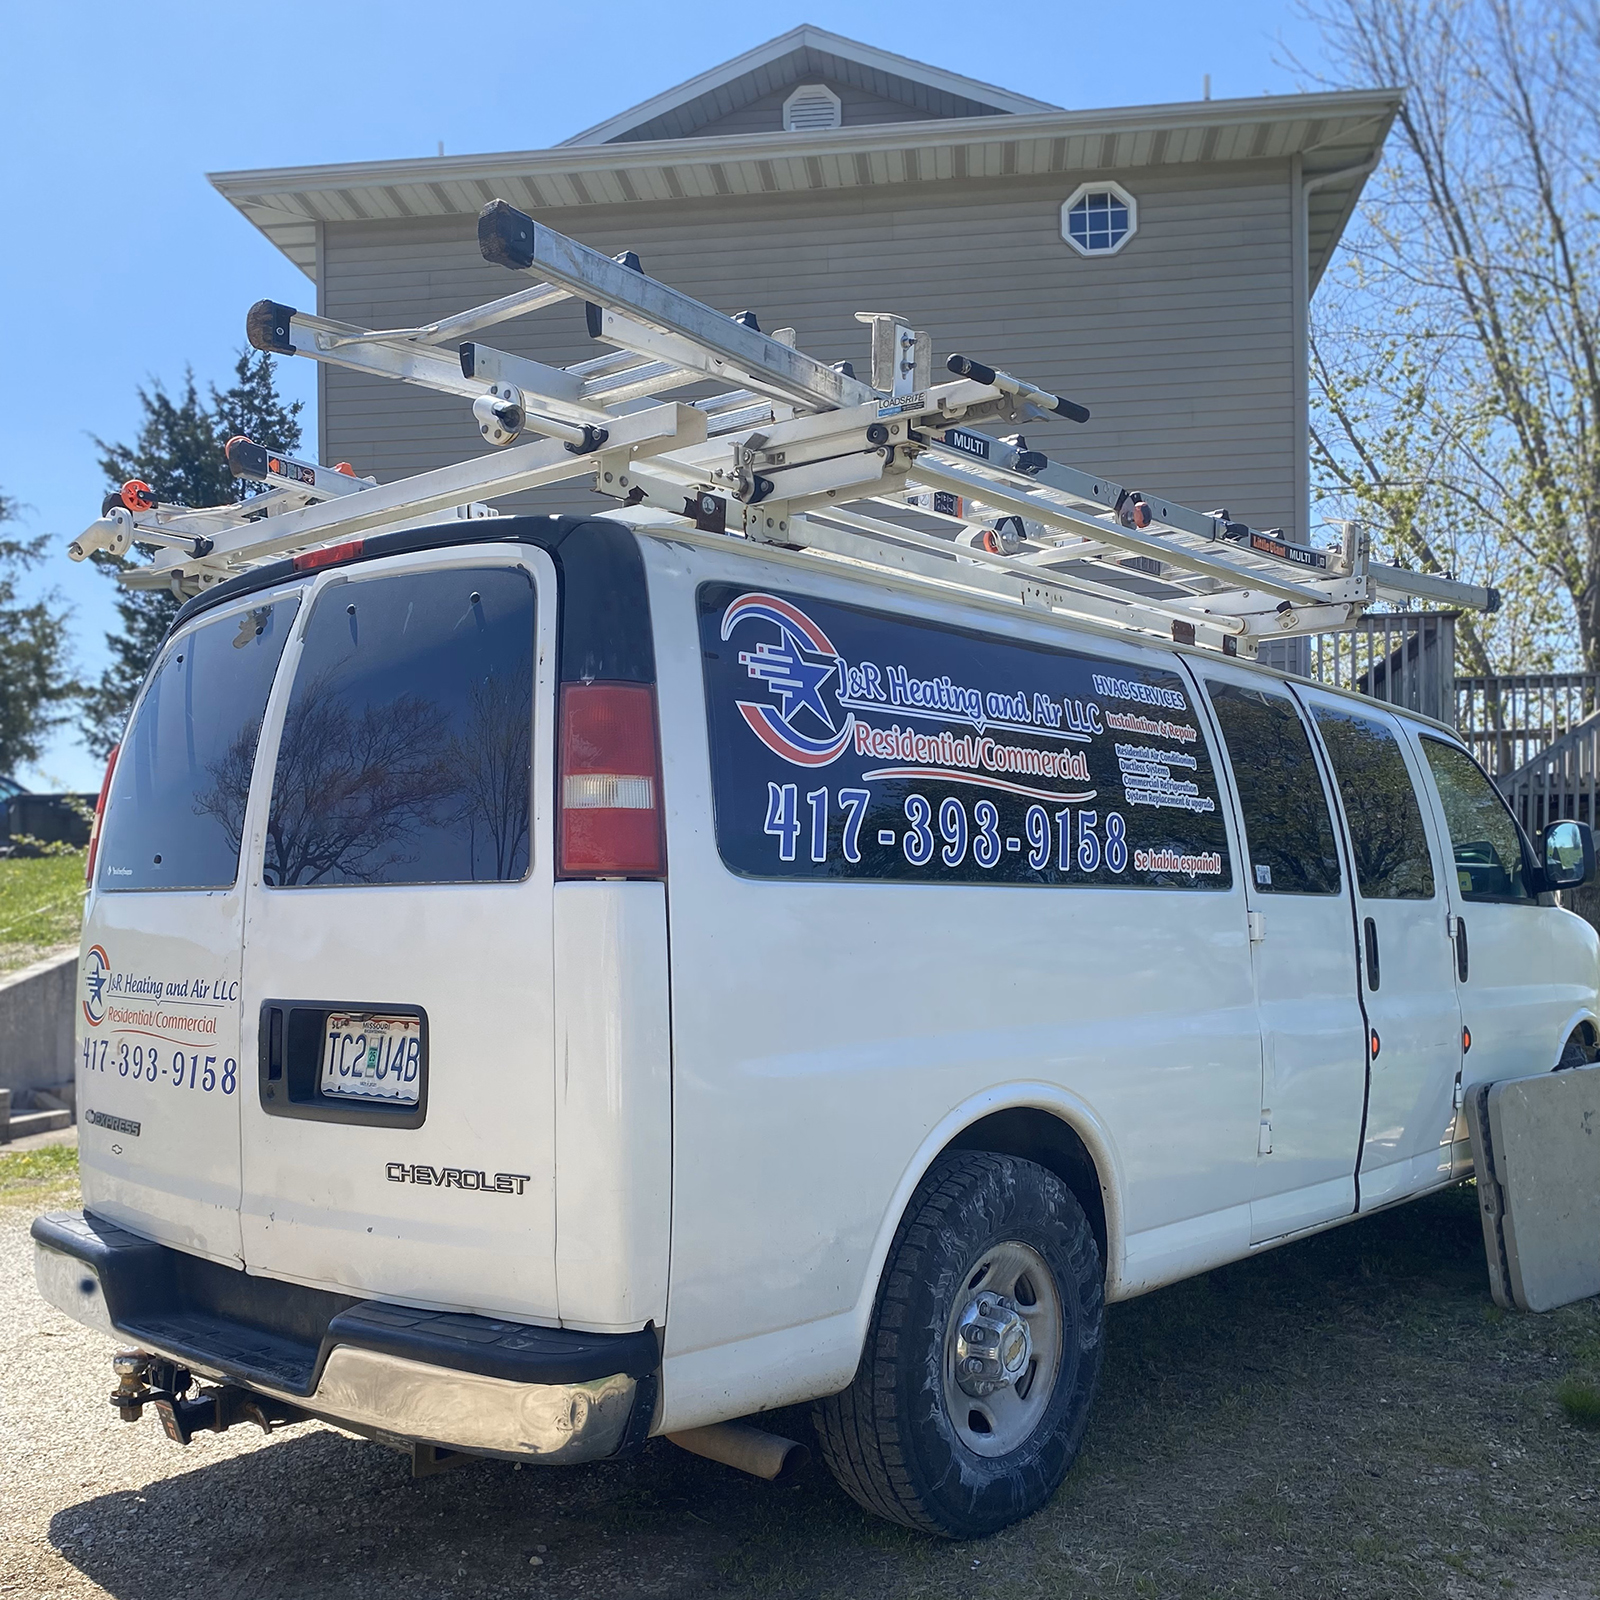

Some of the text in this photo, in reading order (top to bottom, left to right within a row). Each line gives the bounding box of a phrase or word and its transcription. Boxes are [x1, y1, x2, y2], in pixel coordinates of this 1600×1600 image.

[879, 393, 925, 409] LOADSRITE
[953, 431, 984, 455] MULTI
[1289, 548, 1311, 564] MULTI
[835, 658, 1103, 734] J&R Heating and Air LLC
[1092, 674, 1186, 710] HVAC SERVICES
[1106, 711, 1197, 744] Installation & Repair
[853, 721, 1090, 781] Residential/Commercial
[1115, 743, 1197, 771] Residential Air Conditioning
[1119, 758, 1170, 778] Ductless Systems
[1122, 773, 1198, 795] Commercial Refrigeration
[1125, 788, 1148, 806] System
[1148, 791, 1185, 808] Replacement
[1191, 797, 1215, 812] upgrade
[764, 781, 1128, 874] 417-393-9158
[1134, 848, 1221, 878] Se habla español!
[106, 973, 239, 1001] J&R Heating and Air LLC
[108, 1006, 217, 1034] Residential/Commercial
[363, 1022, 390, 1031] MISSOURI
[83, 1037, 237, 1095] 417-393-9158
[95, 1112, 140, 1137] EXPRESS
[385, 1162, 530, 1195] CHEVROLET
